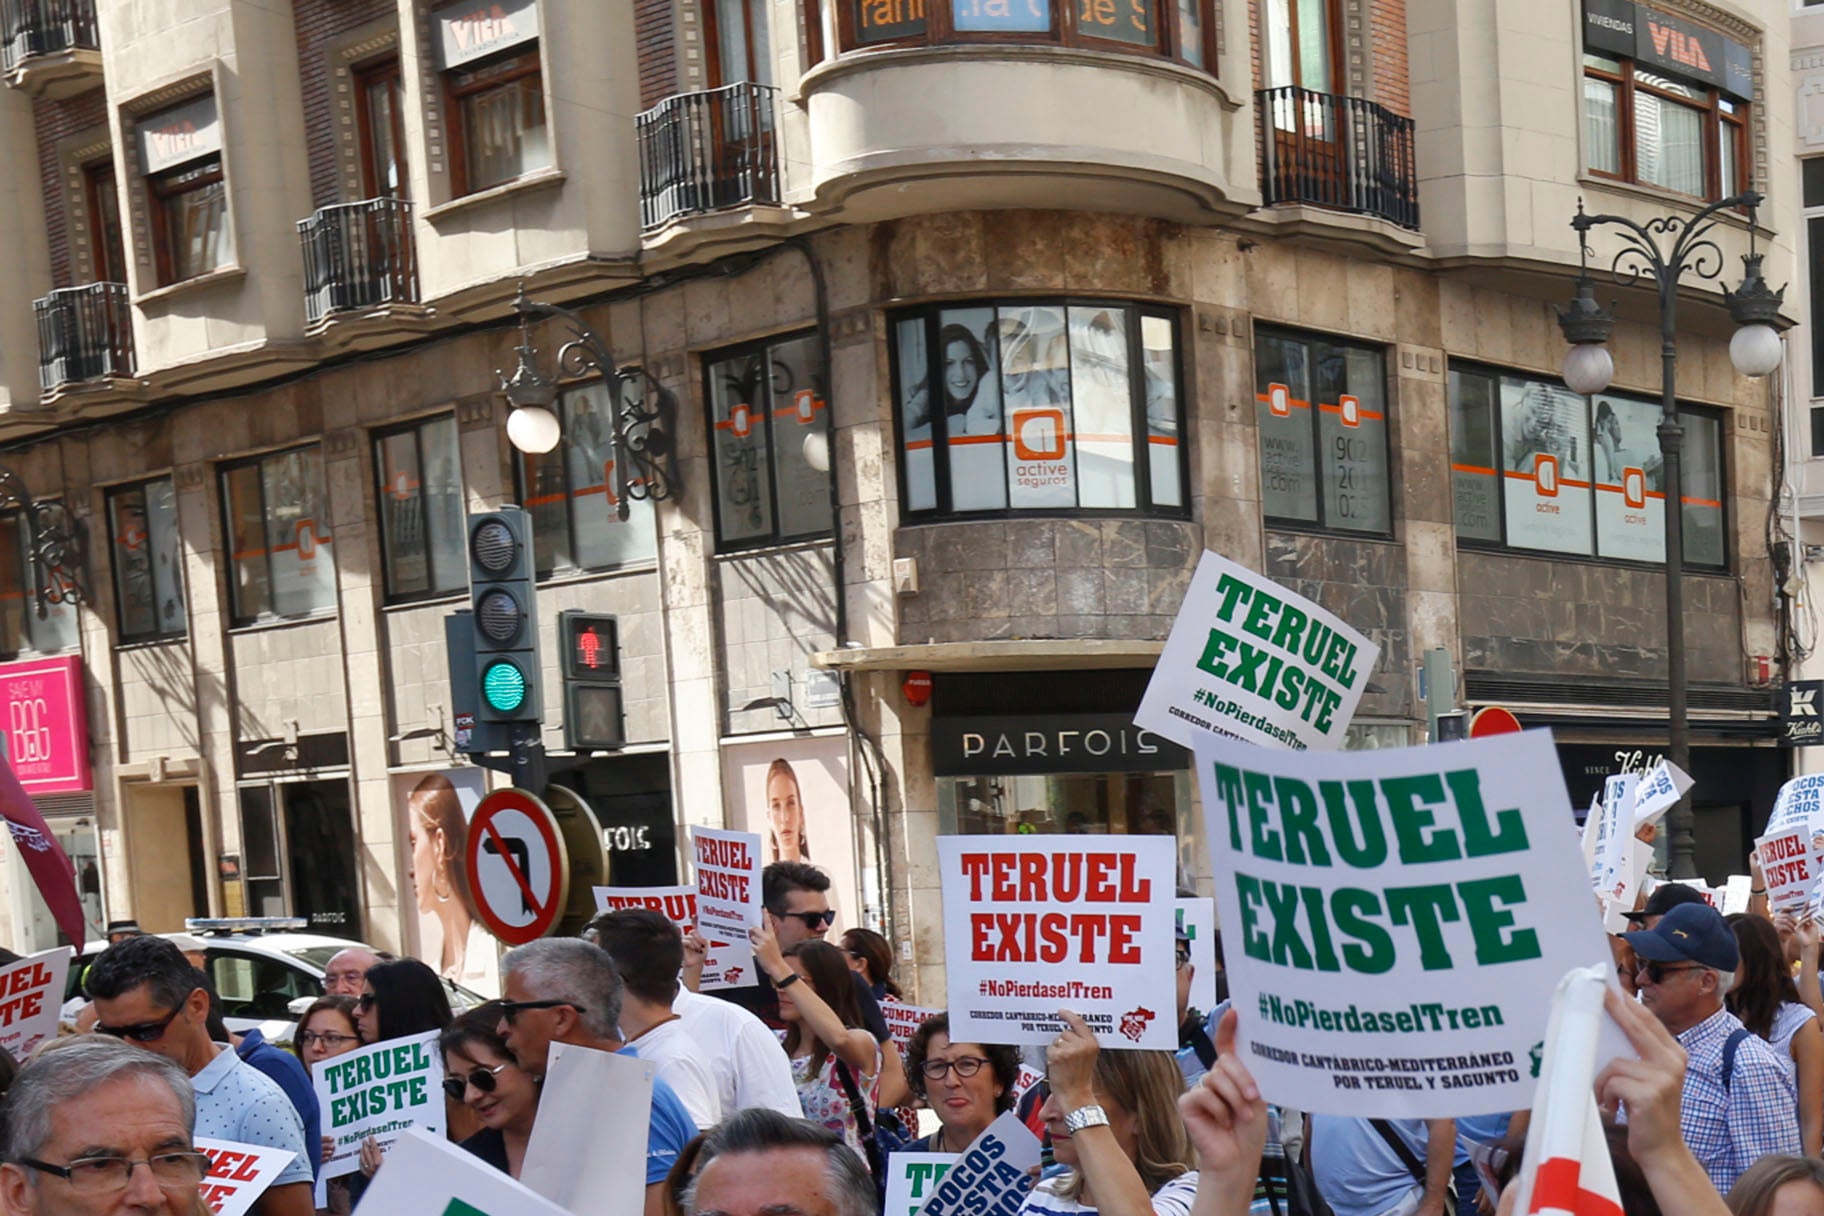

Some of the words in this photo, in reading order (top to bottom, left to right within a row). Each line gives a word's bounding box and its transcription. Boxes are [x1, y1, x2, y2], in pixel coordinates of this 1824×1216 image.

[1587, 12, 1633, 34] VIVIENDAS
[1648, 21, 1712, 72] VILA
[1016, 460, 1068, 477] active
[1017, 476, 1068, 488] seguros
[1216, 573, 1358, 690] TERUEL
[1196, 628, 1342, 735] EXISTE
[963, 730, 1159, 757] PARFOIS
[1788, 788, 1819, 804] ESTA
[1792, 776, 1824, 791] OCOS
[1214, 761, 1530, 869] TERUEL
[695, 835, 752, 871] TERUEL
[1761, 834, 1806, 864] TERUEL
[698, 868, 750, 904] EXISTE
[961, 853, 1151, 902] TERUEL
[970, 913, 1142, 964] EXISTE
[1234, 871, 1543, 975] EXISTE
[979, 980, 1112, 1000] #NoPierdaselTren
[1258, 993, 1504, 1034] #NoPierdaselTren
[325, 1043, 429, 1095] TERUEL
[1334, 1075, 1361, 1089] POR
[1365, 1074, 1422, 1091] TERUEL
[1426, 1075, 1436, 1091] Y
[1441, 1069, 1520, 1089] SAGUNTO
[331, 1075, 428, 1128] EXISTE
